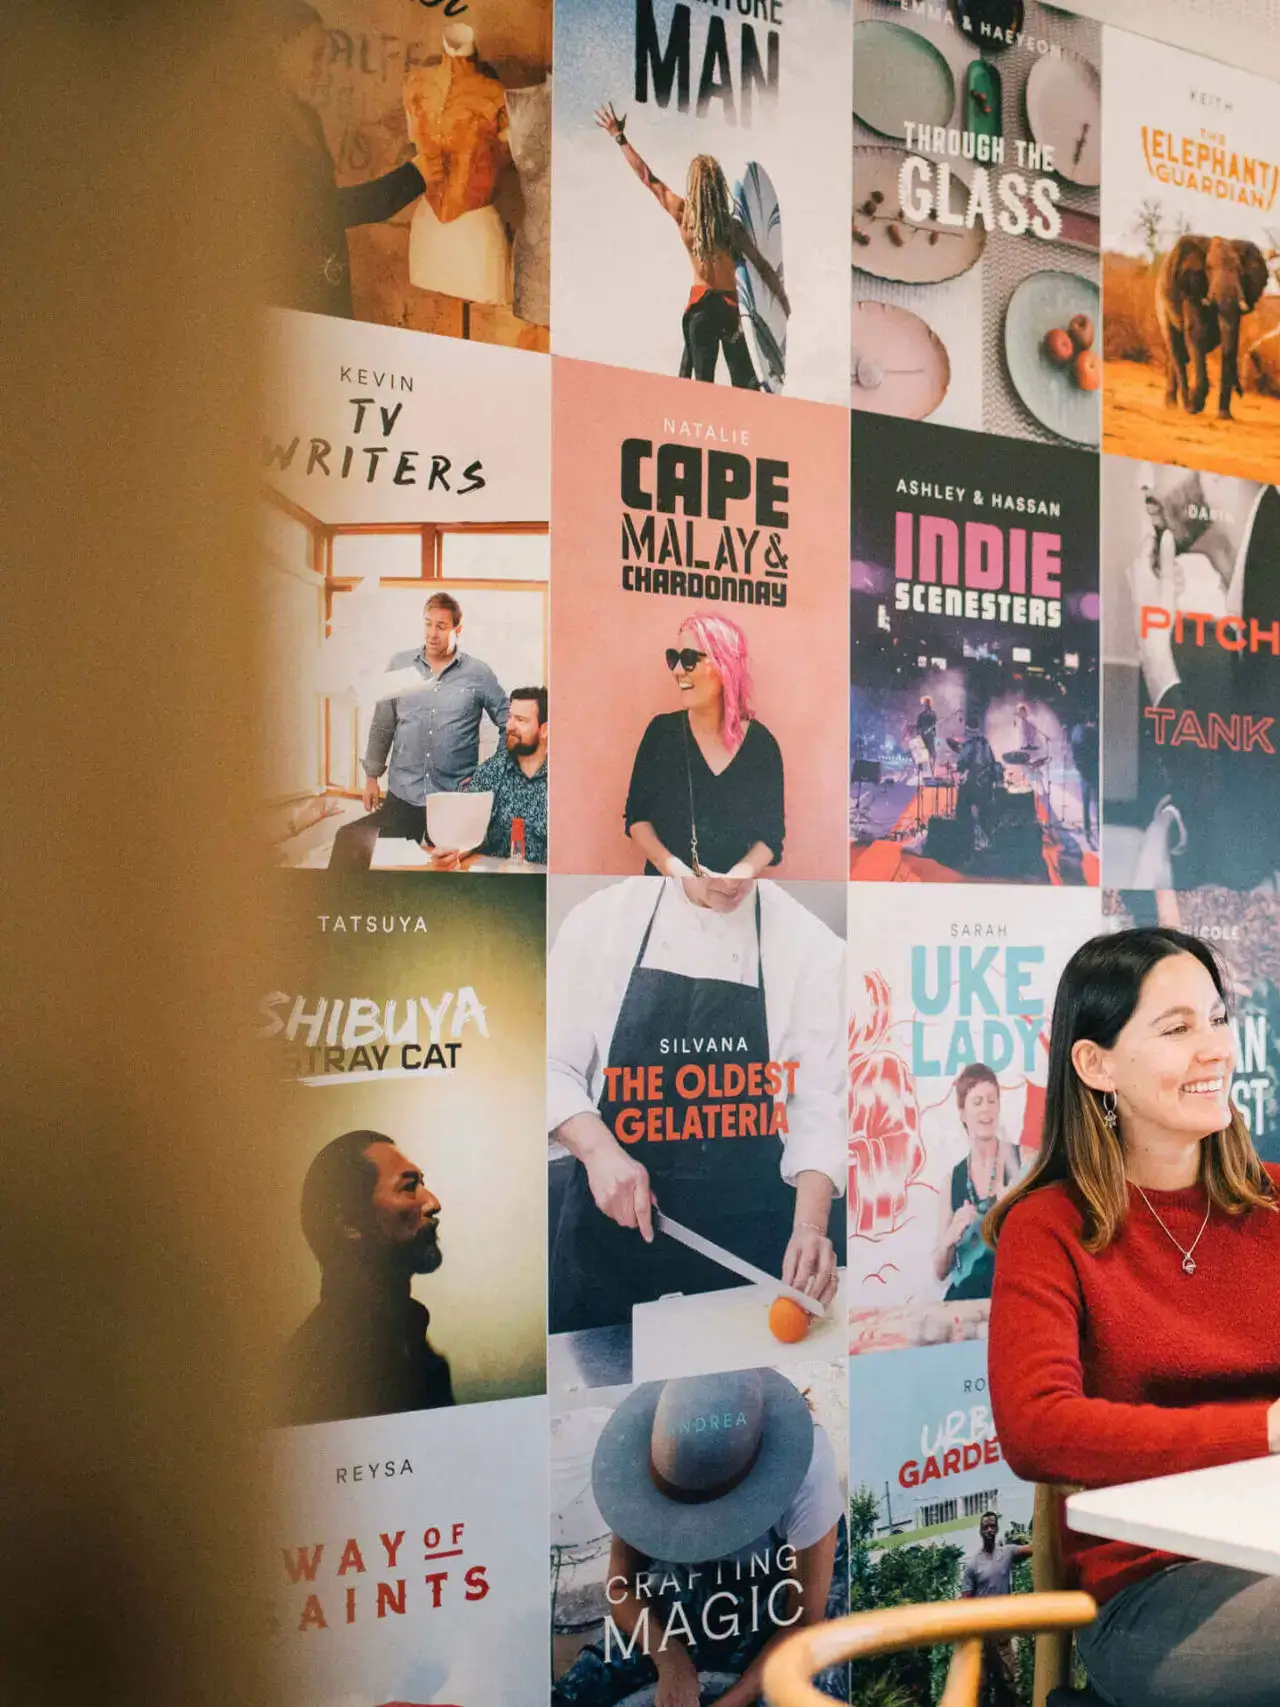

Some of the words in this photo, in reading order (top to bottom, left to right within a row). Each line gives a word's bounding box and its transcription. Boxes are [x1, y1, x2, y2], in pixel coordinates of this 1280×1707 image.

[962, 15, 973, 32] &
[635, 0, 780, 130] MAN
[903, 121, 1004, 164] THROUGH
[1014, 140, 1055, 172] THE
[1152, 128, 1270, 190] ELEPHANT
[898, 157, 1063, 240] GLASS
[1156, 164, 1265, 209] GUARDIAN
[340, 365, 415, 392] KEVIN
[349, 398, 403, 437] TV
[663, 418, 750, 446] NATALIE
[261, 435, 486, 495] WRITERS
[621, 438, 789, 529] CAPE
[896, 478, 965, 502] ASHLEY
[973, 489, 984, 506] &
[991, 493, 1061, 518] HASSAN
[621, 512, 761, 575] MALAY
[764, 532, 789, 570] &
[895, 511, 1062, 599] INDIE
[622, 565, 787, 608] CHARDONNAY
[895, 581, 1062, 629] SCENESTERS
[1140, 605, 1280, 656] PITCH
[1144, 706, 1276, 755] TANK
[317, 915, 428, 933] TATSUYA
[950, 923, 1008, 937] SARAH
[911, 945, 1045, 1017] UKE
[256, 986, 490, 1050] SHIBUYA
[300, 1045, 390, 1073] TRAY
[401, 1043, 462, 1070] CAT
[660, 1037, 749, 1054] SILVANA
[911, 1018, 1045, 1077] LADY
[603, 1065, 664, 1102] THE
[675, 1061, 800, 1100] OLDEST
[614, 1102, 789, 1145] GELATERIA
[964, 1377, 986, 1393] RO
[671, 1411, 748, 1434] NDREA
[336, 1458, 413, 1484] REYSA
[898, 1436, 1000, 1489] GARDE
[281, 1530, 406, 1584] WAY
[423, 1522, 464, 1549] OF
[297, 1565, 490, 1632] AINTS
[604, 1578, 804, 1664] MAGIC
